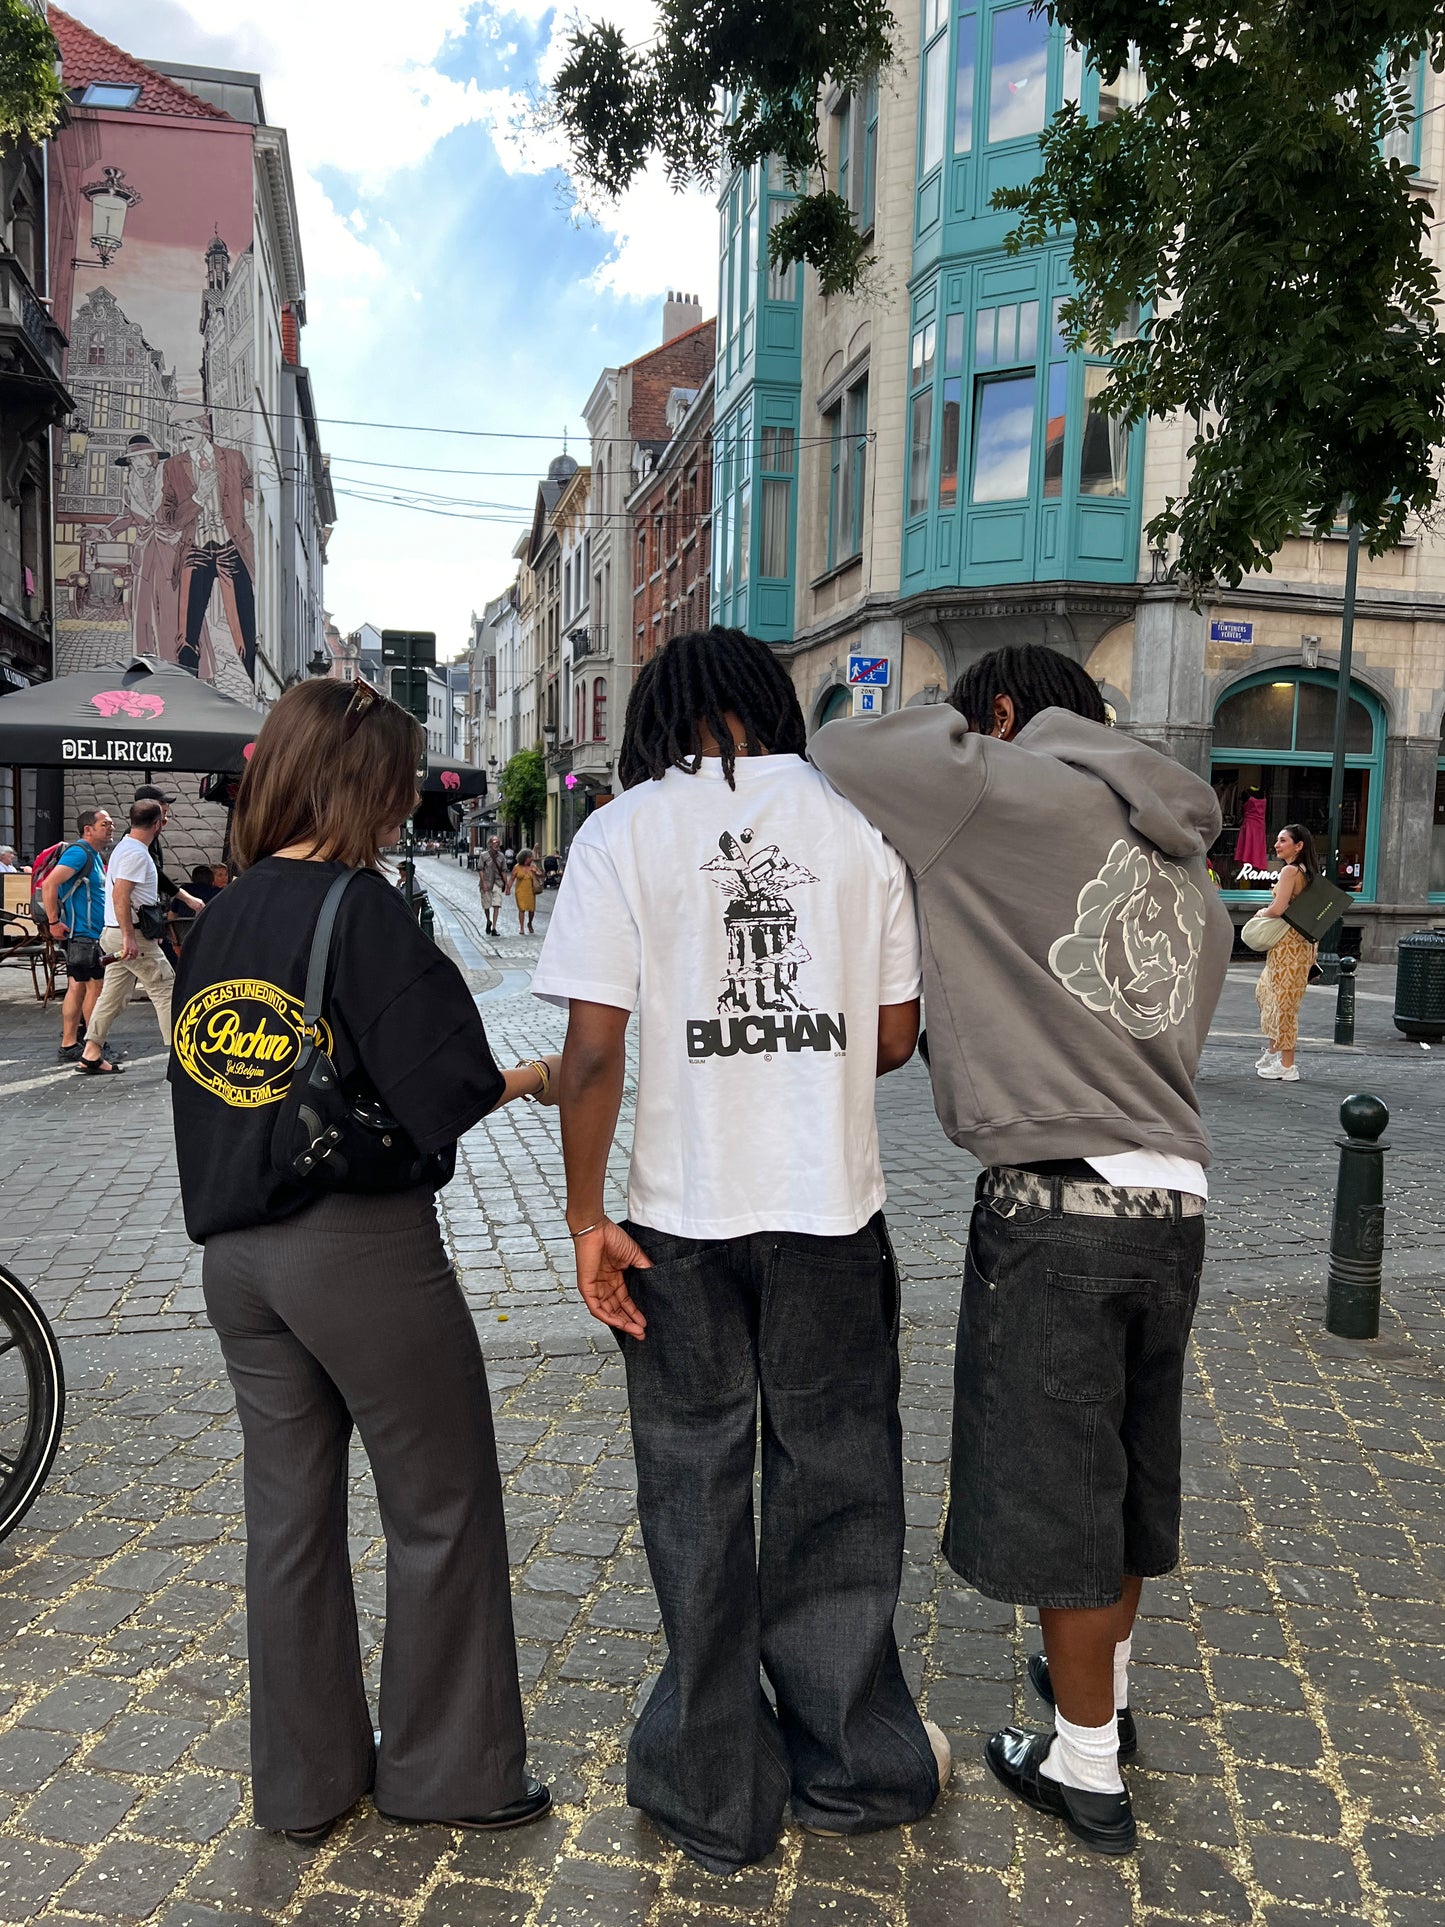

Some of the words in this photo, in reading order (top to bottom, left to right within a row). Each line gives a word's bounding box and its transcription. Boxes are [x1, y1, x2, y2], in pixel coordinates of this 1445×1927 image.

[61, 739, 173, 763] DELIRIUM
[201, 985, 234, 1010] IDEAS
[233, 984, 269, 1000] TUNED
[268, 989, 288, 1014] INTO
[200, 1009, 293, 1062] Buchan
[686, 1012, 847, 1058] BUCHAN
